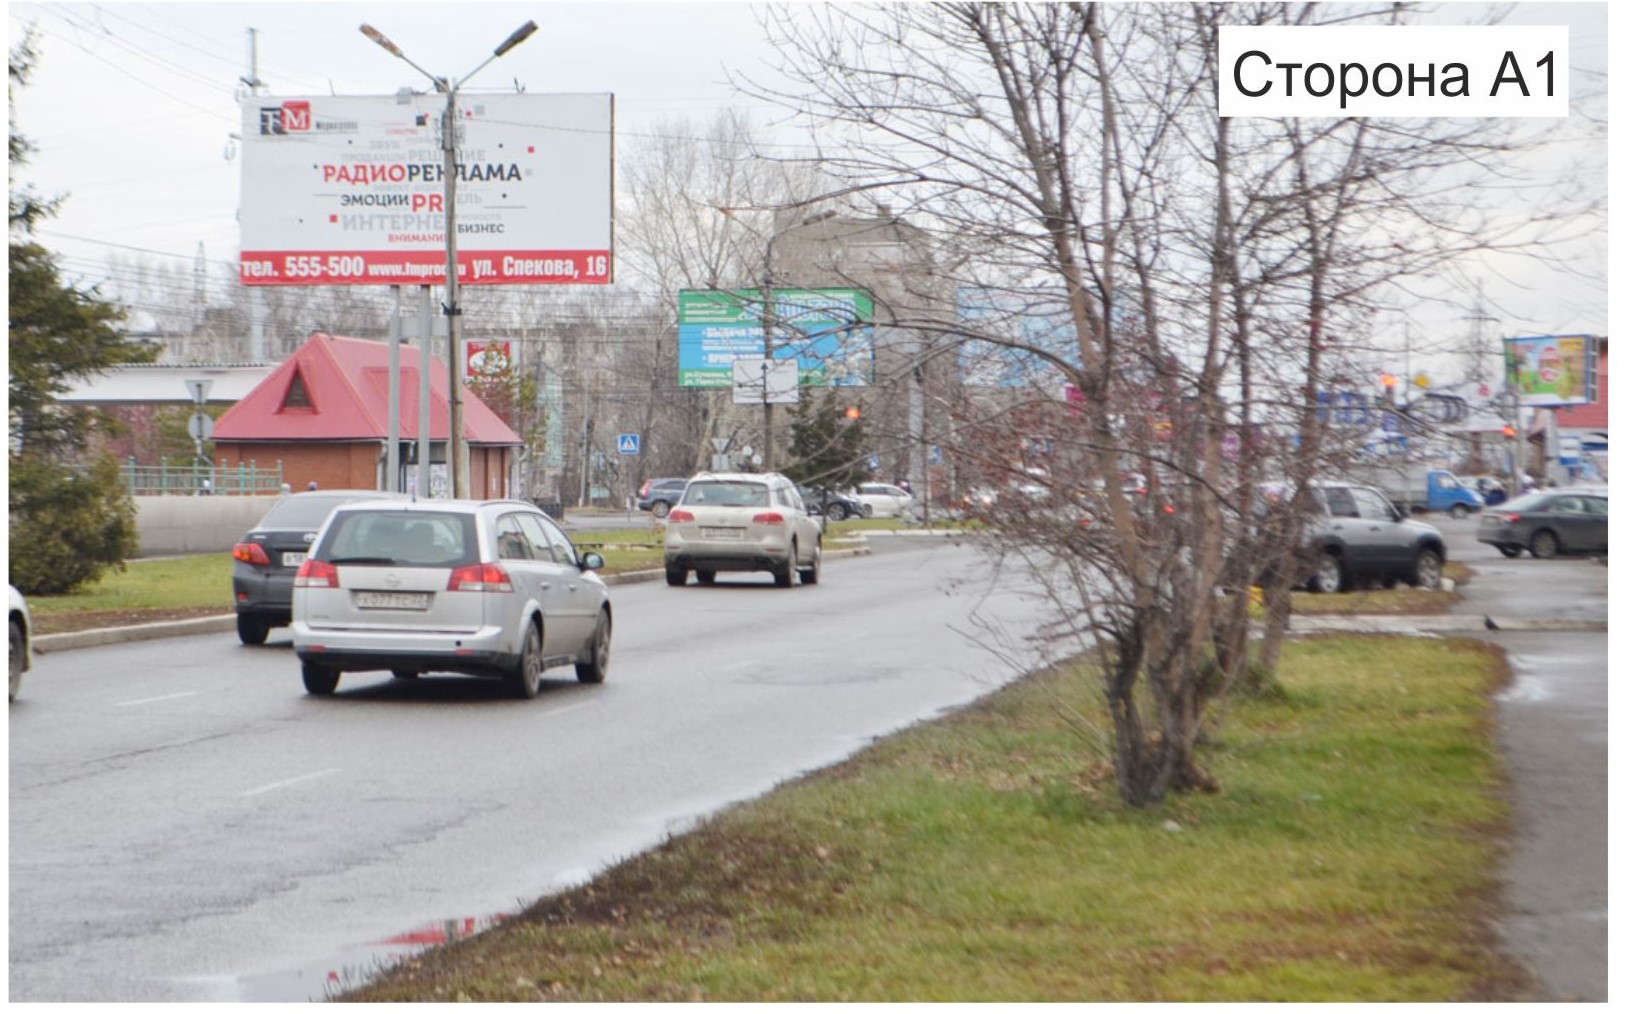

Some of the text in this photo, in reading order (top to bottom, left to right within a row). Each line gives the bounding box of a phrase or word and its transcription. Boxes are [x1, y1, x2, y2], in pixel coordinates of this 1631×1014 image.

[408, 150, 486, 162] РЕШИЕ
[340, 193, 483, 213] ЭМОЦИИ PR ЕЛЬ
[341, 214, 446, 231] ИНТЕРНЕ
[457, 223, 505, 234] БИЗНЕС
[388, 234, 447, 244] ВНИМАНИ
[241, 259, 279, 278] тел.
[284, 256, 365, 277] 555-500
[473, 259, 498, 280] ул.
[503, 256, 580, 280] Спекова,
[586, 256, 607, 276] 16
